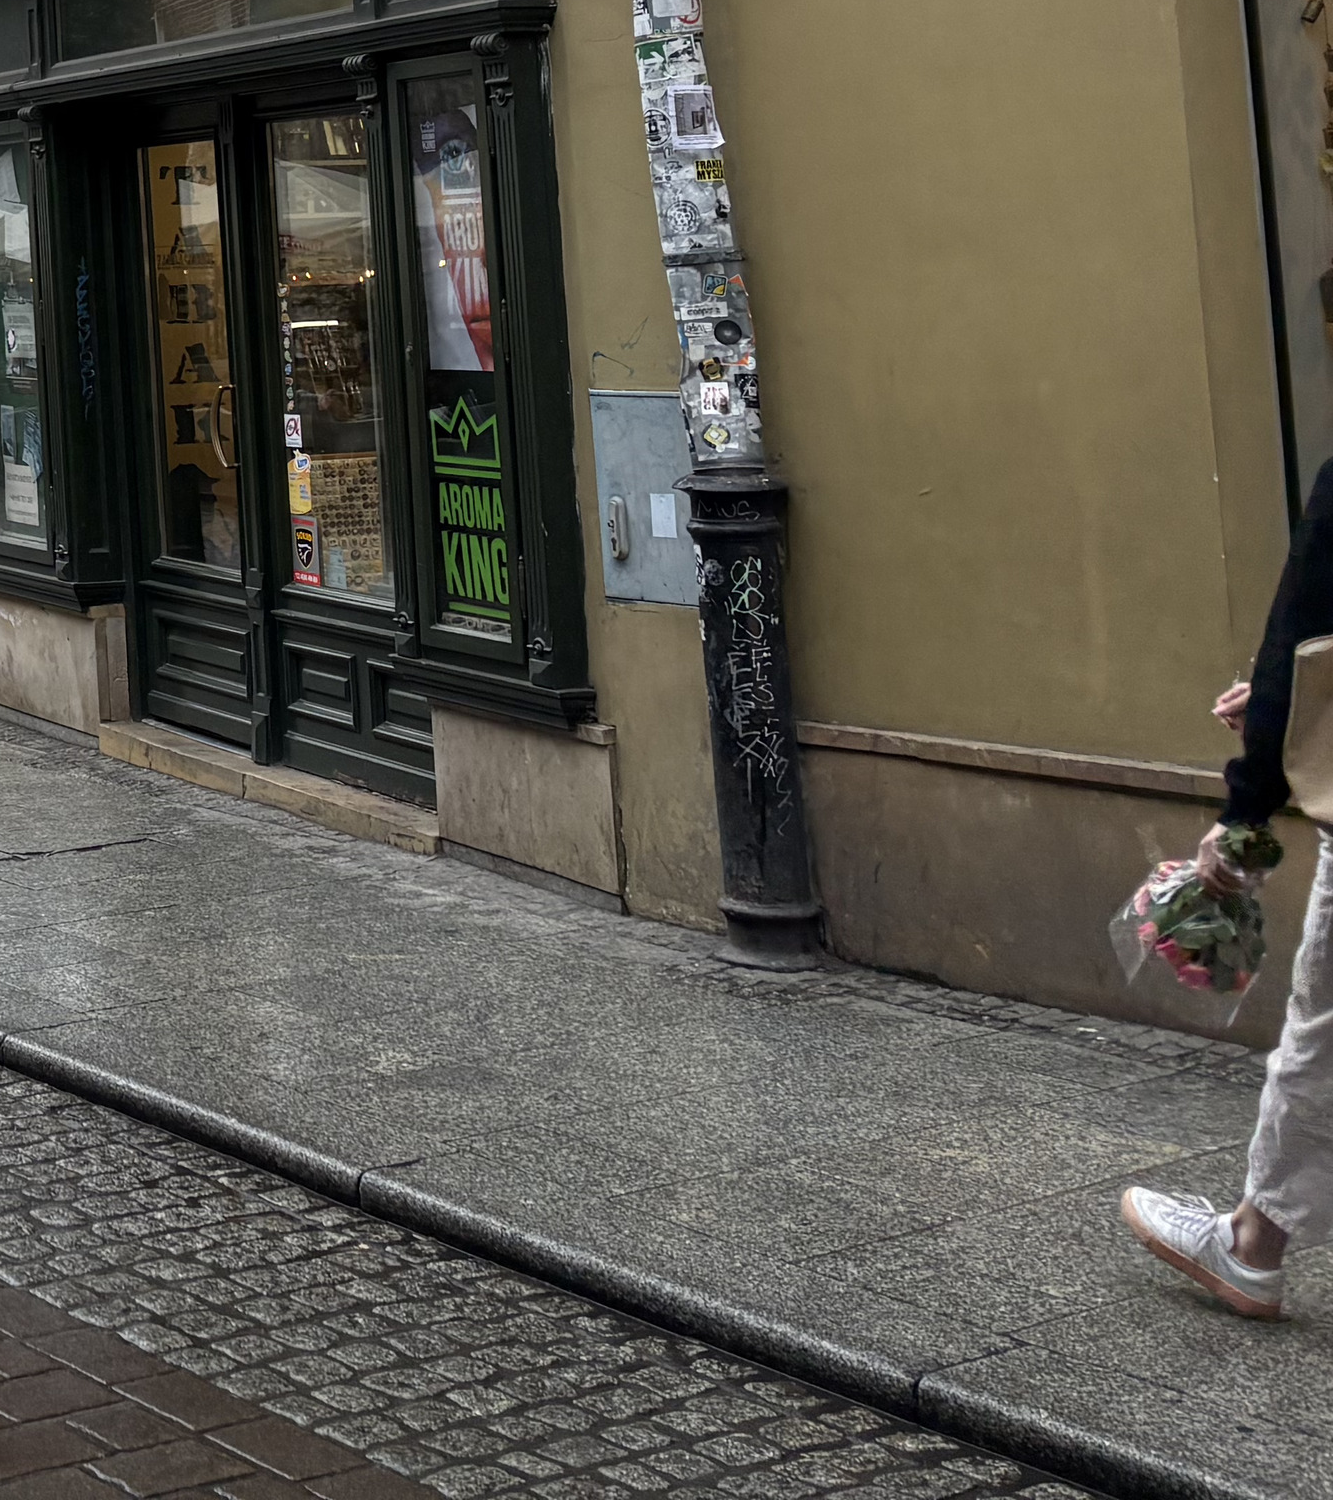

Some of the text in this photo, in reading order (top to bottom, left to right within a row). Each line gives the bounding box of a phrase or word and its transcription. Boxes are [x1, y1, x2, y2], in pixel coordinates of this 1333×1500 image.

[444, 211, 484, 252] ARO
[439, 481, 505, 531] AROMA
[441, 530, 510, 605] KING
